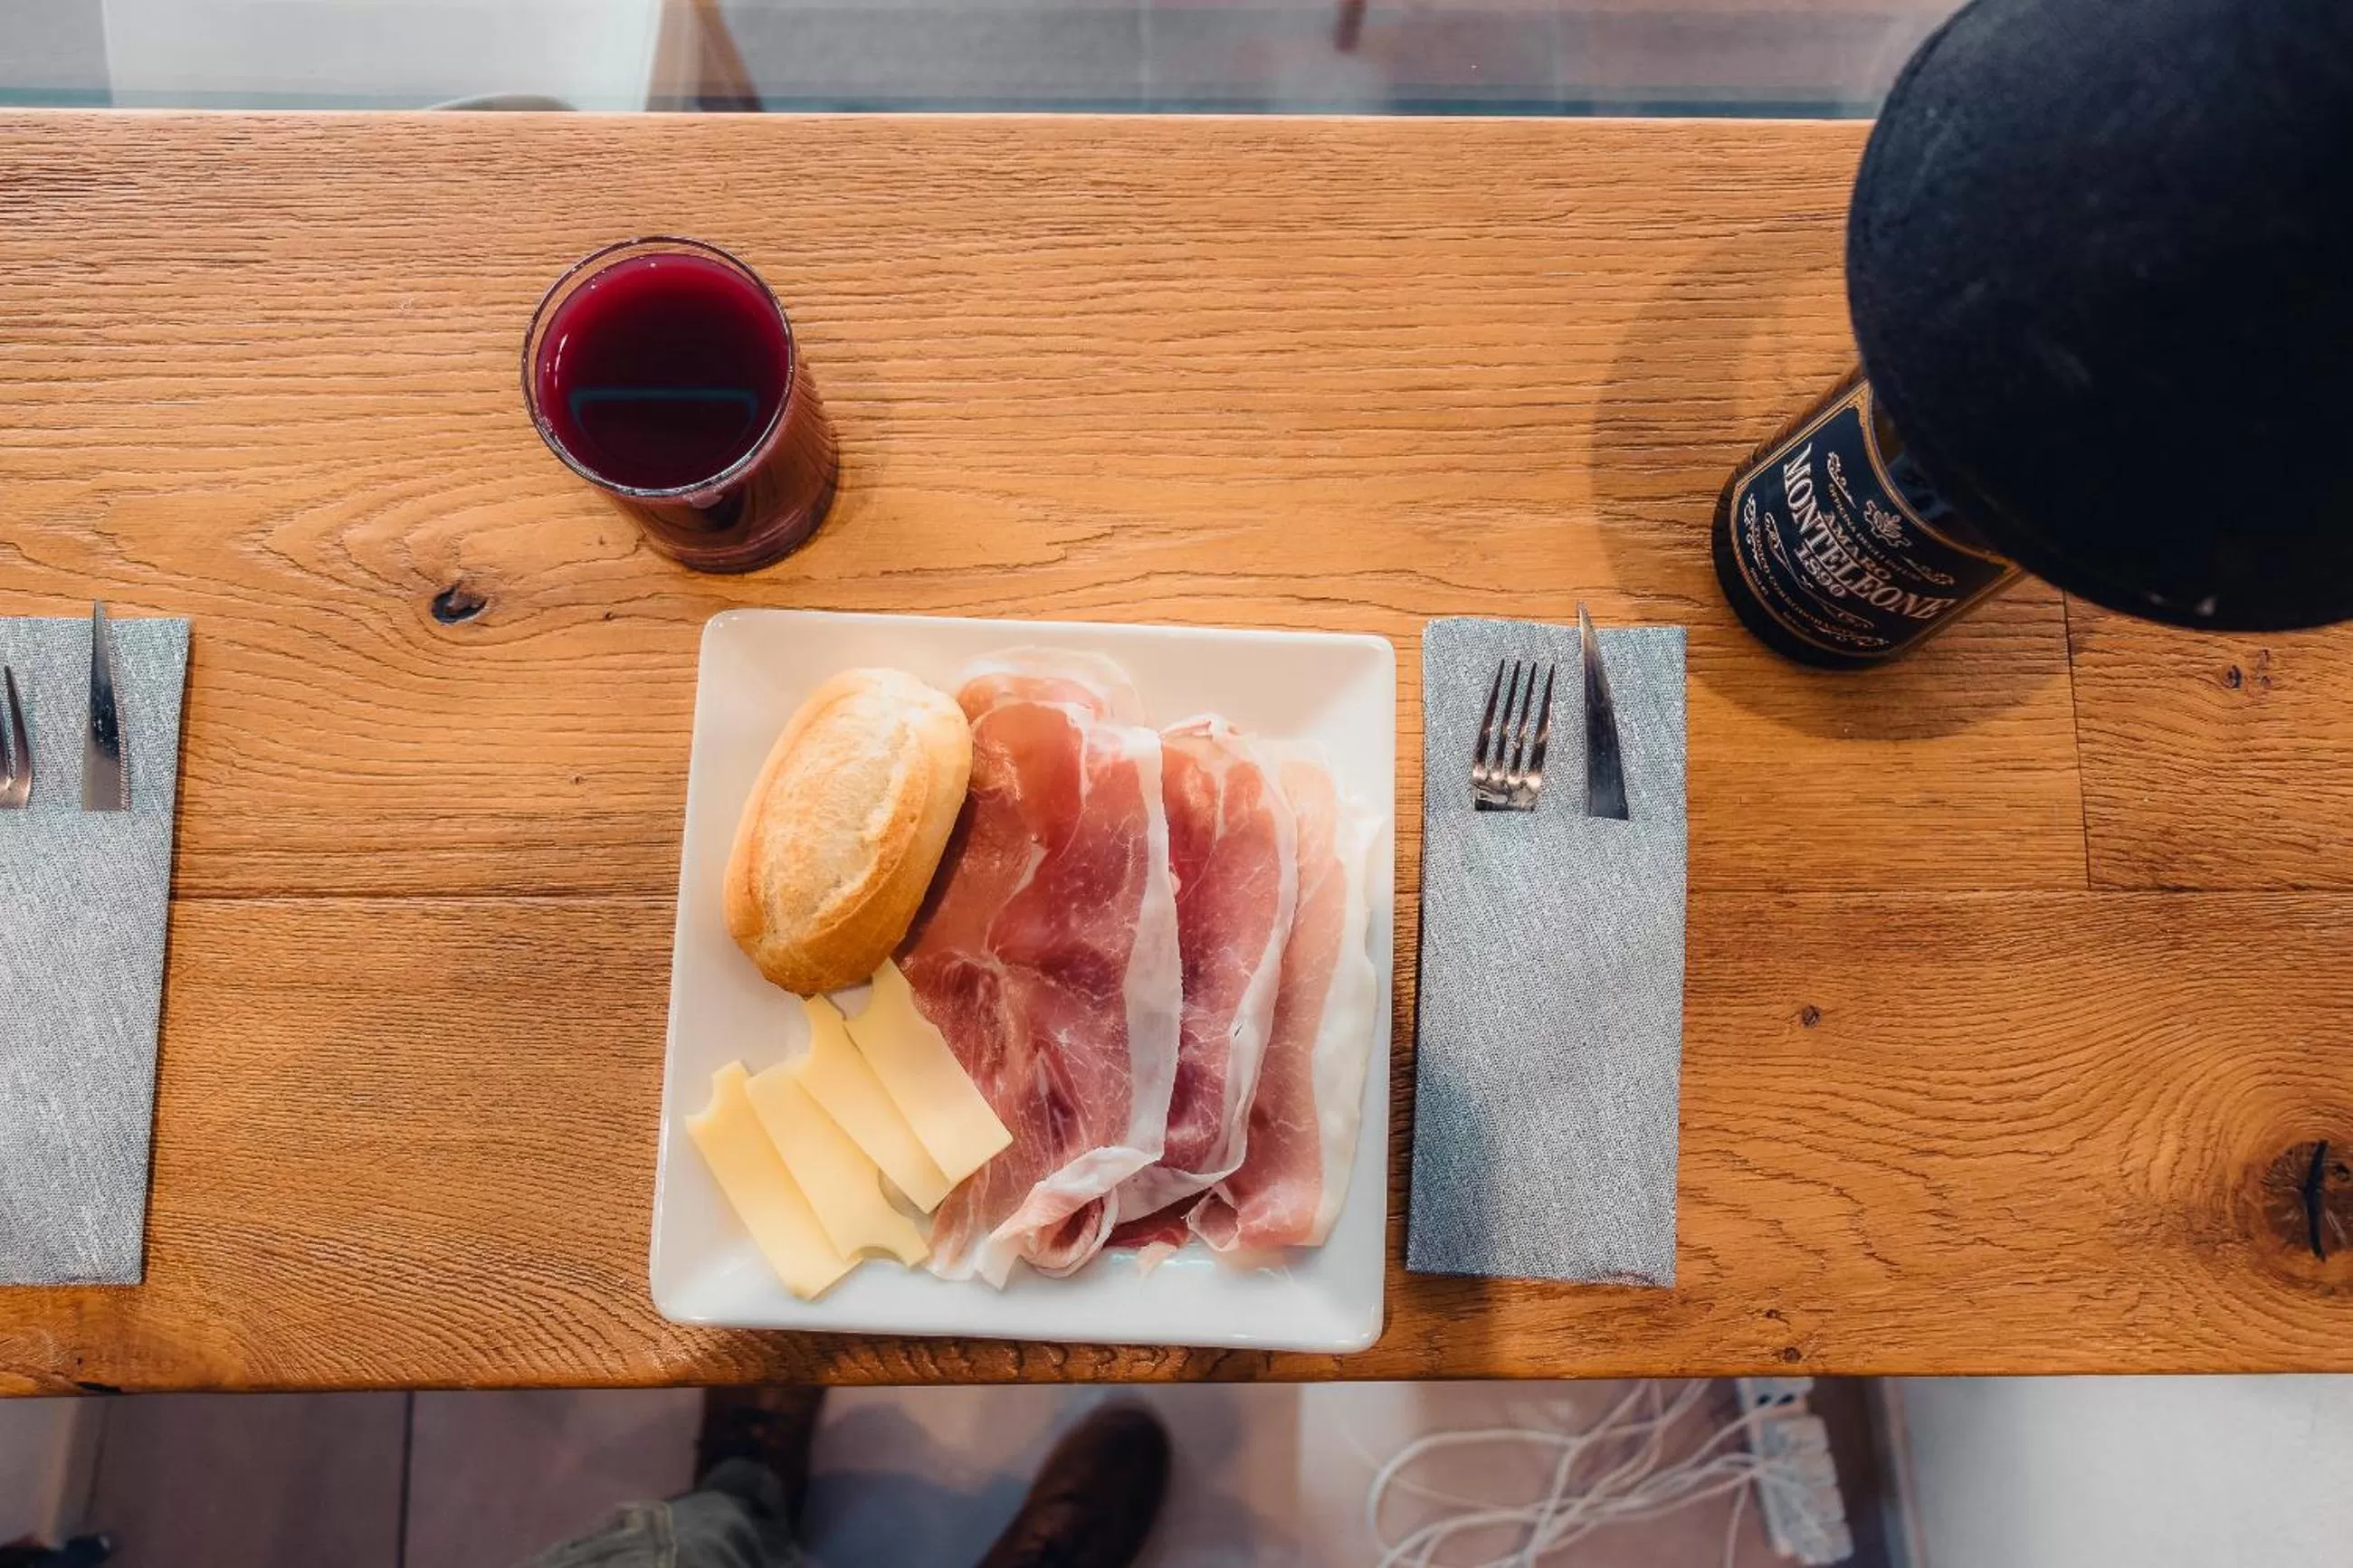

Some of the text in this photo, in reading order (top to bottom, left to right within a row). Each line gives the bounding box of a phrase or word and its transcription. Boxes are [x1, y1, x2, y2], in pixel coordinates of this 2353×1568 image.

[1783, 442, 1956, 619] MONTELEONE
[1823, 510, 1891, 580] AMARO
[1794, 543, 1848, 597] 1890
